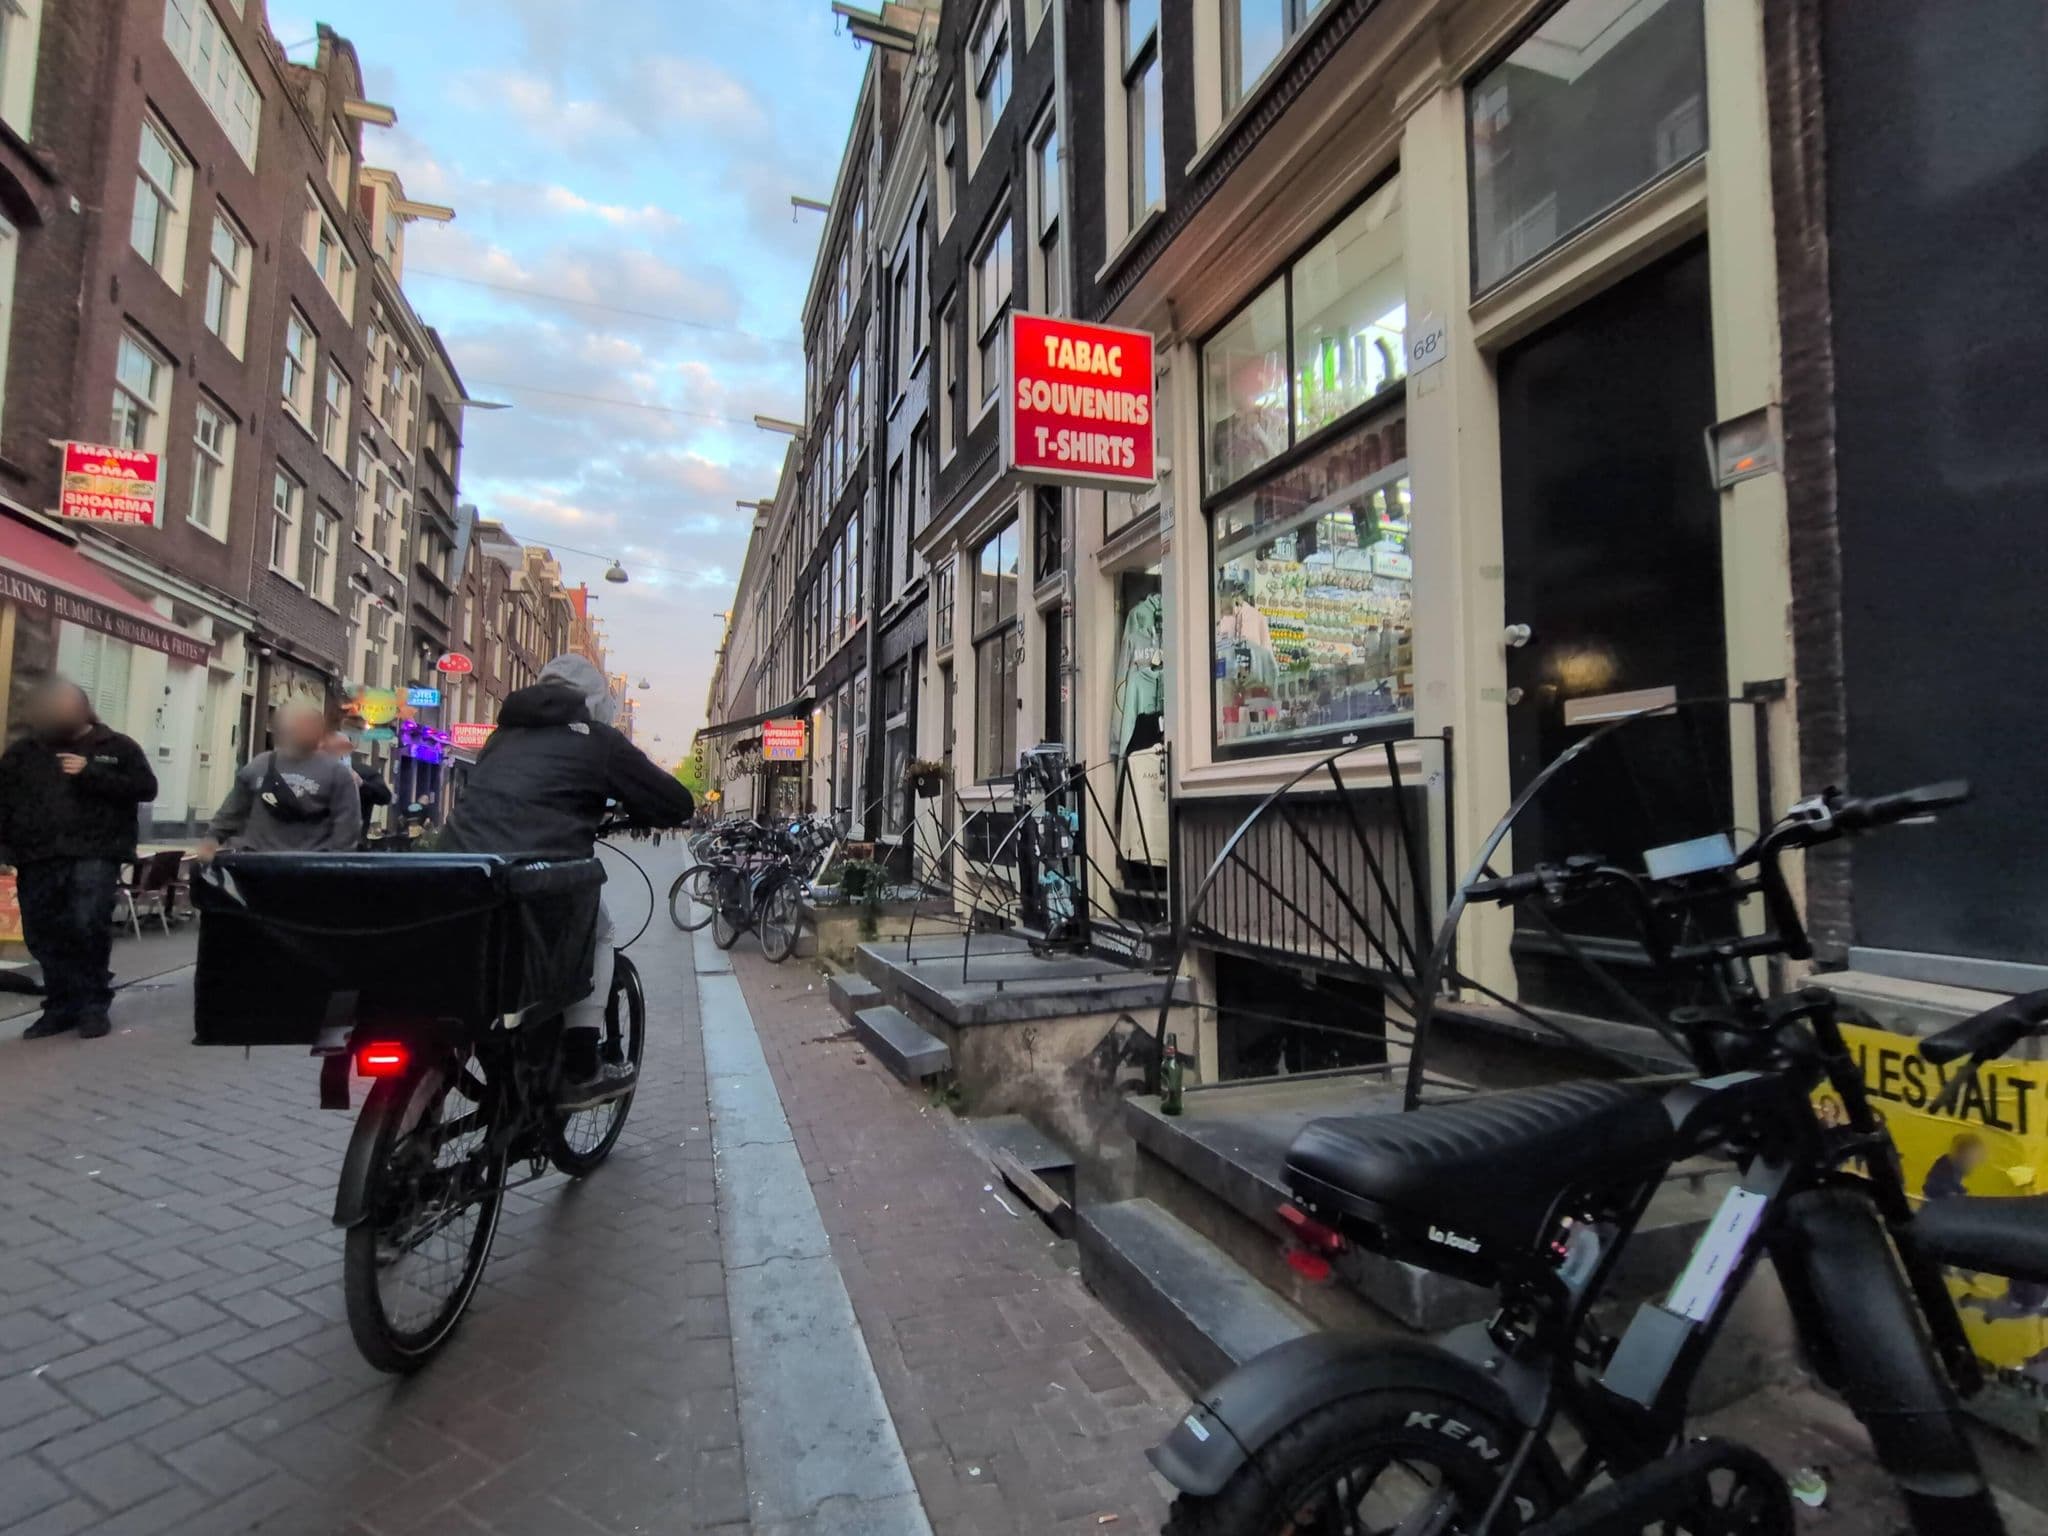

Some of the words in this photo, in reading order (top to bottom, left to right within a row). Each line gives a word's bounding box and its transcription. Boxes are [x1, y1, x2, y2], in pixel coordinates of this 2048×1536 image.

[1044, 335, 1122, 378] TABAC
[1018, 377, 1149, 426] SOUVENIRS
[75, 443, 150, 463] MAMA
[1034, 426, 1136, 468] T-SHIRTS
[83, 463, 139, 480] OMA
[64, 493, 152, 513] SHOARMA
[69, 505, 145, 525] FALAFEL
[54, 593, 103, 625] HUMMUS
[104, 613, 112, 631] &
[116, 618, 160, 648] SHOARMA
[162, 634, 170, 651] &
[768, 737, 800, 746] SOUVENIRS
[772, 747, 795, 757] ATM
